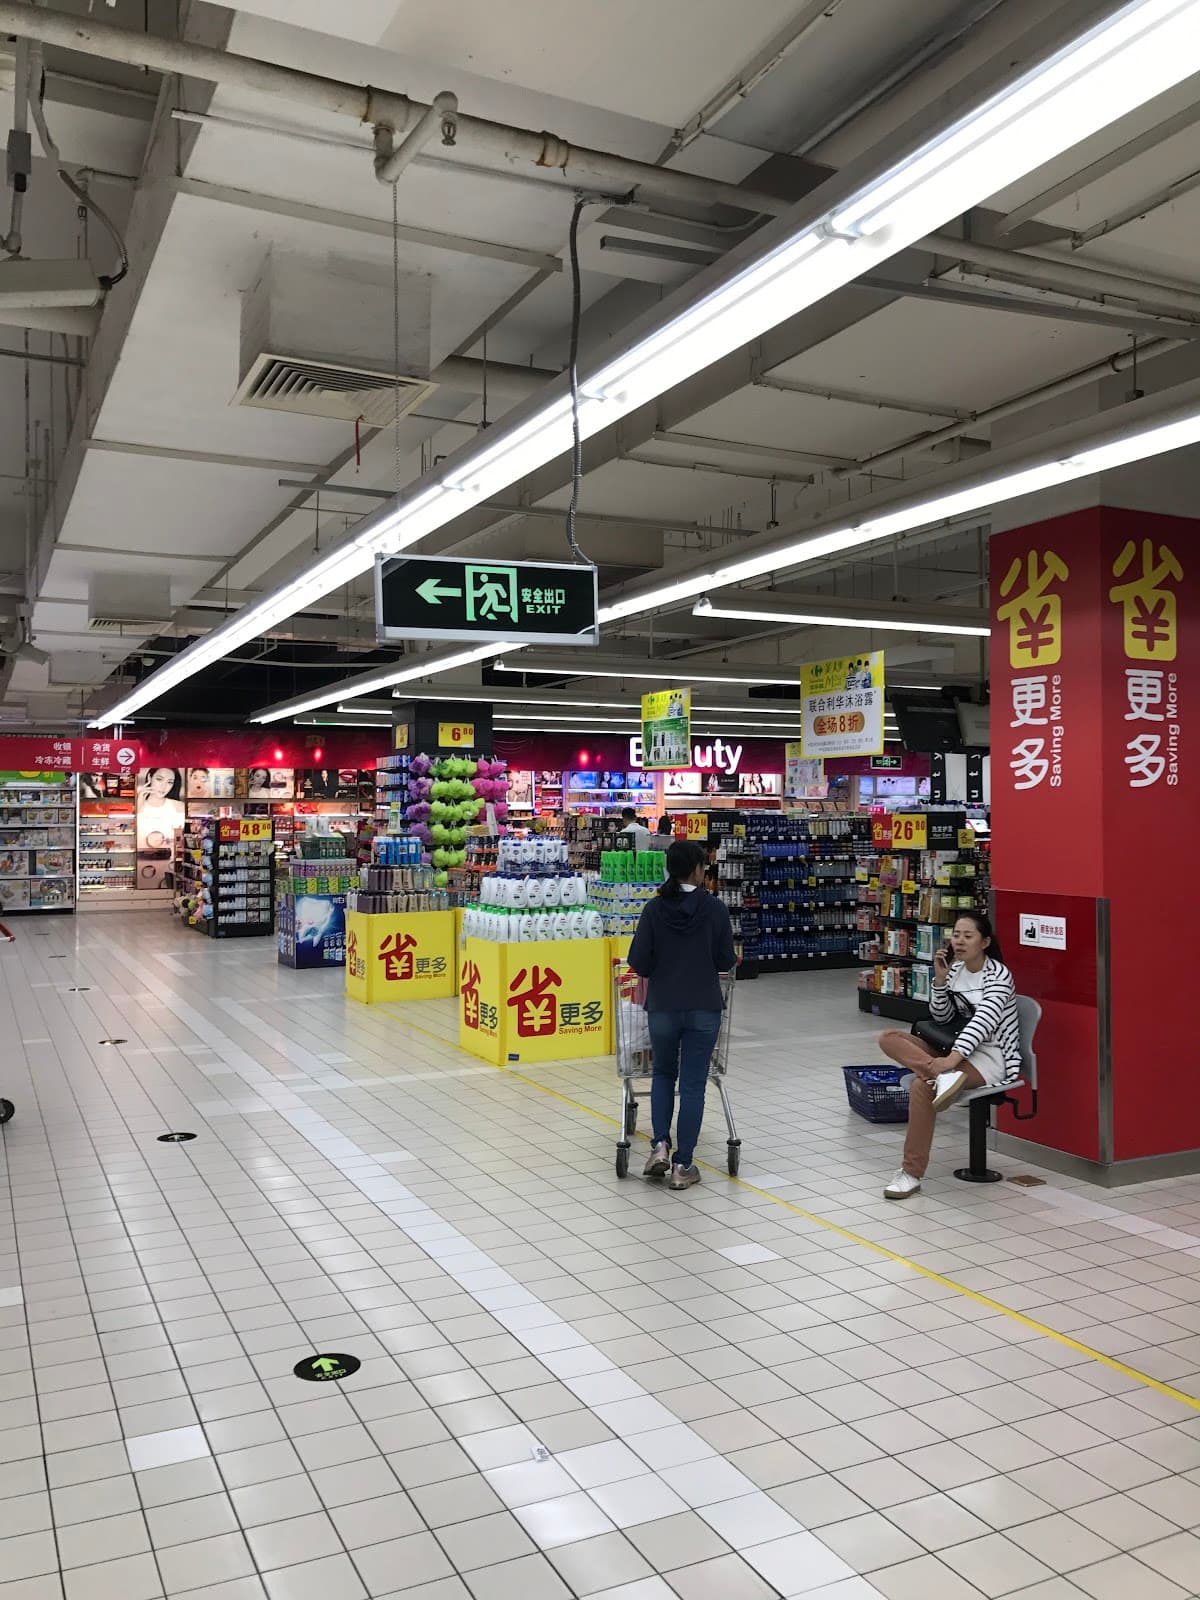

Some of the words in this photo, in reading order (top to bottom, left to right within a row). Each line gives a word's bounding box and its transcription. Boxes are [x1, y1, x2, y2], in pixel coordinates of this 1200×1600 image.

[521, 588, 566, 604] 安全出口
[526, 604, 562, 615] EXIT
[808, 691, 874, 713] 联合利华沐浴露
[1051, 674, 1062, 721] More
[1165, 672, 1178, 719] More
[817, 714, 859, 735] 全场8折
[53, 742, 72, 751] 收银
[92, 743, 111, 752] 杂货
[629, 737, 743, 775] Buty
[1051, 725, 1064, 787] Saving
[1167, 724, 1180, 786] Saving
[35, 756, 72, 765] 冷冻冷藏
[91, 757, 110, 766] 生鲜
[415, 956, 447, 974] 更多
[479, 1002, 498, 1030] 更多
[559, 1001, 603, 1027] 更多
[559, 1027, 583, 1035] Saving
[584, 1025, 602, 1033] More
